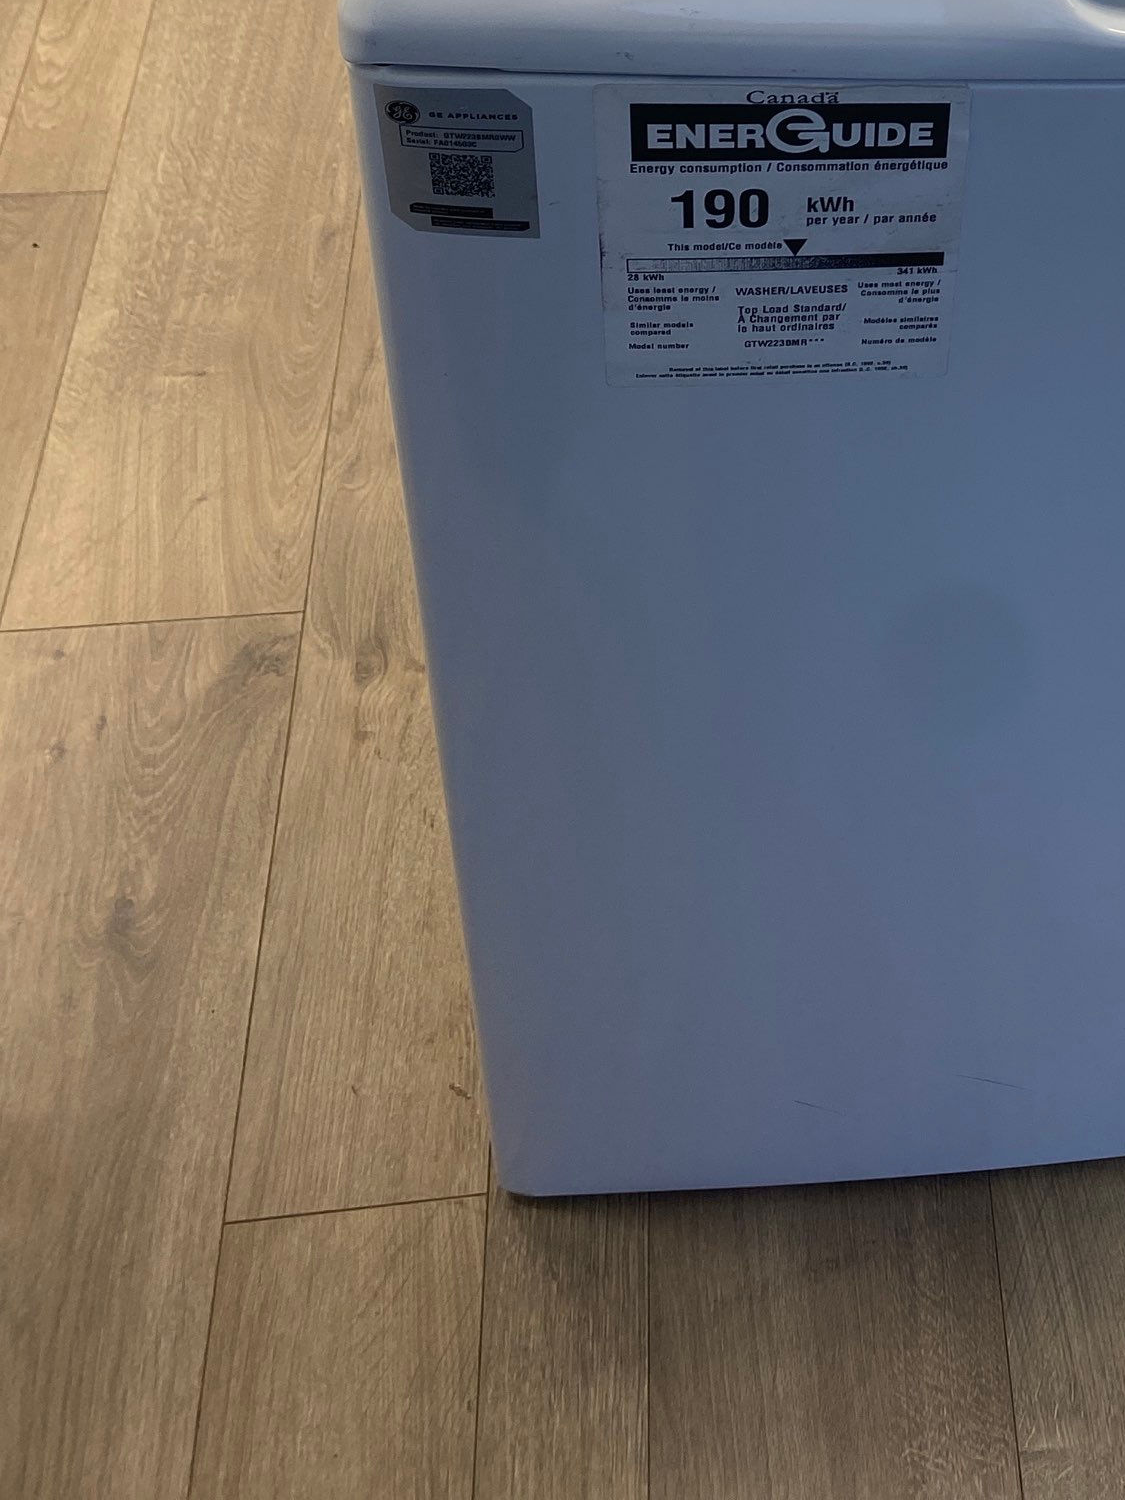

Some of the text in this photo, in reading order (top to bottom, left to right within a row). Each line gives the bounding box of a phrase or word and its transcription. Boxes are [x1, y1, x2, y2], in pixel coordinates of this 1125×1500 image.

[746, 90, 840, 104] Canada
[447, 112, 519, 120] APPLIANCES
[647, 108, 934, 153] ENERGUIDE
[630, 163, 675, 175] Energy
[679, 162, 762, 175] consumption
[776, 160, 870, 173] Consommation
[874, 159, 949, 174] énergétique
[670, 188, 769, 229] 190
[806, 196, 855, 213] kWh
[806, 216, 829, 227] per
[832, 215, 860, 227] year
[873, 214, 894, 226] par
[898, 211, 937, 224] année
[667, 241, 783, 251] This model/Ce modèle
[896, 266, 938, 275] 341 kWh
[643, 273, 665, 281] kWh
[735, 284, 848, 296] WASHER/LAVEUSES
[737, 303, 847, 316] Top Load Standard/
[822, 313, 841, 322] par
[630, 321, 661, 329] Similar
[737, 322, 835, 333] le haut ordinaires
[630, 329, 671, 337] compared
[657, 342, 690, 350] number
